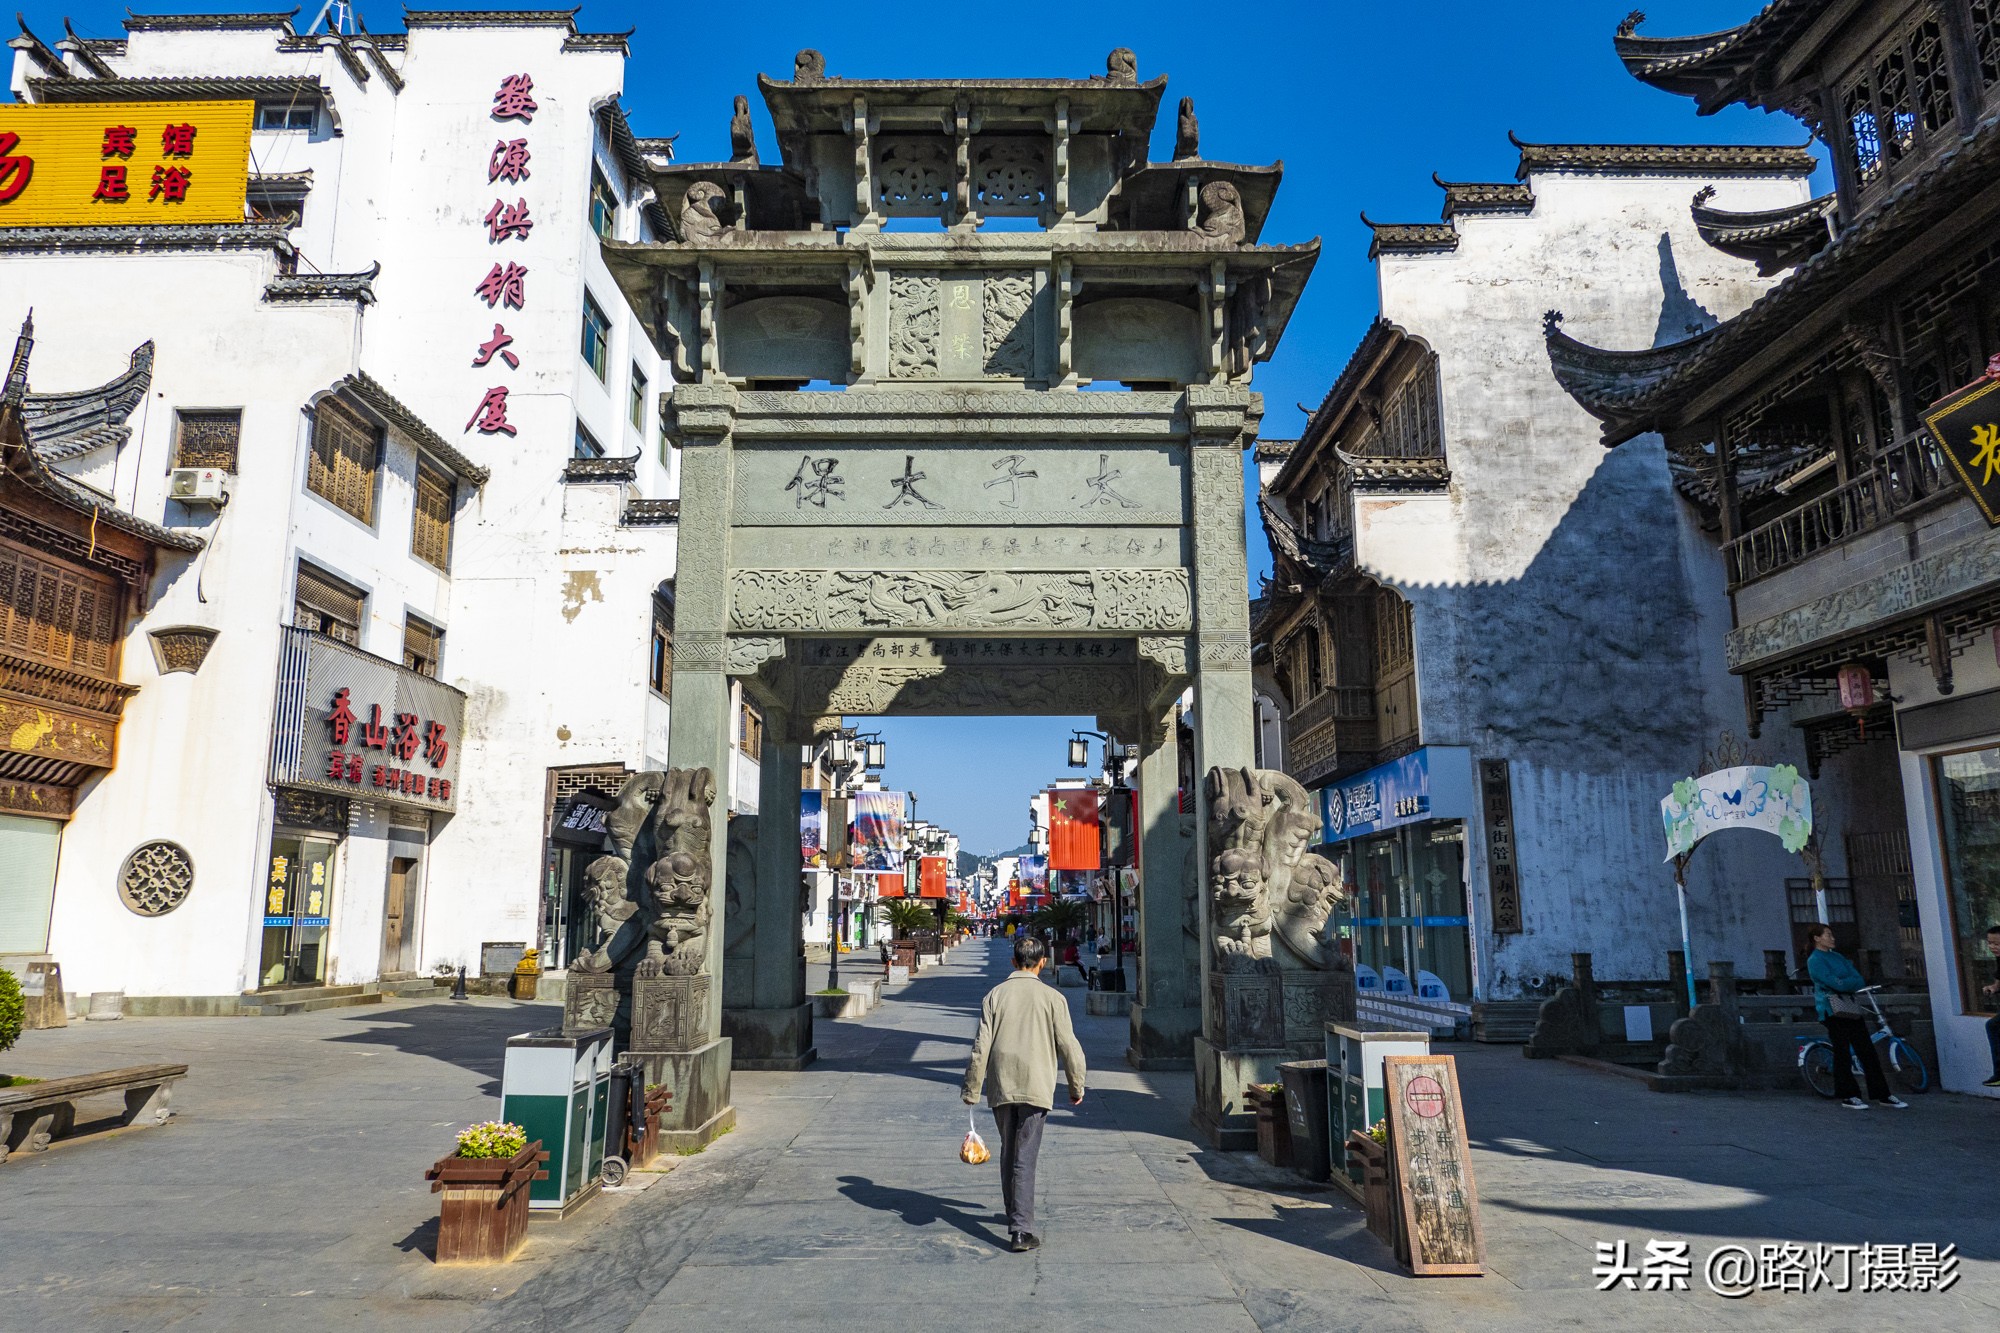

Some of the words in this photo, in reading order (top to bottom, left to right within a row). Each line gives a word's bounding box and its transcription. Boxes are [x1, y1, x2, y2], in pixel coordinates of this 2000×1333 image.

[101, 123, 196, 158] 宾馆
[92, 165, 191, 202] 足浴
[466, 73, 538, 435] 婺源供销大厦
[326, 687, 449, 768] 香山浴场
[328, 751, 364, 783] 宾馆
[269, 855, 288, 914] 宾馆
